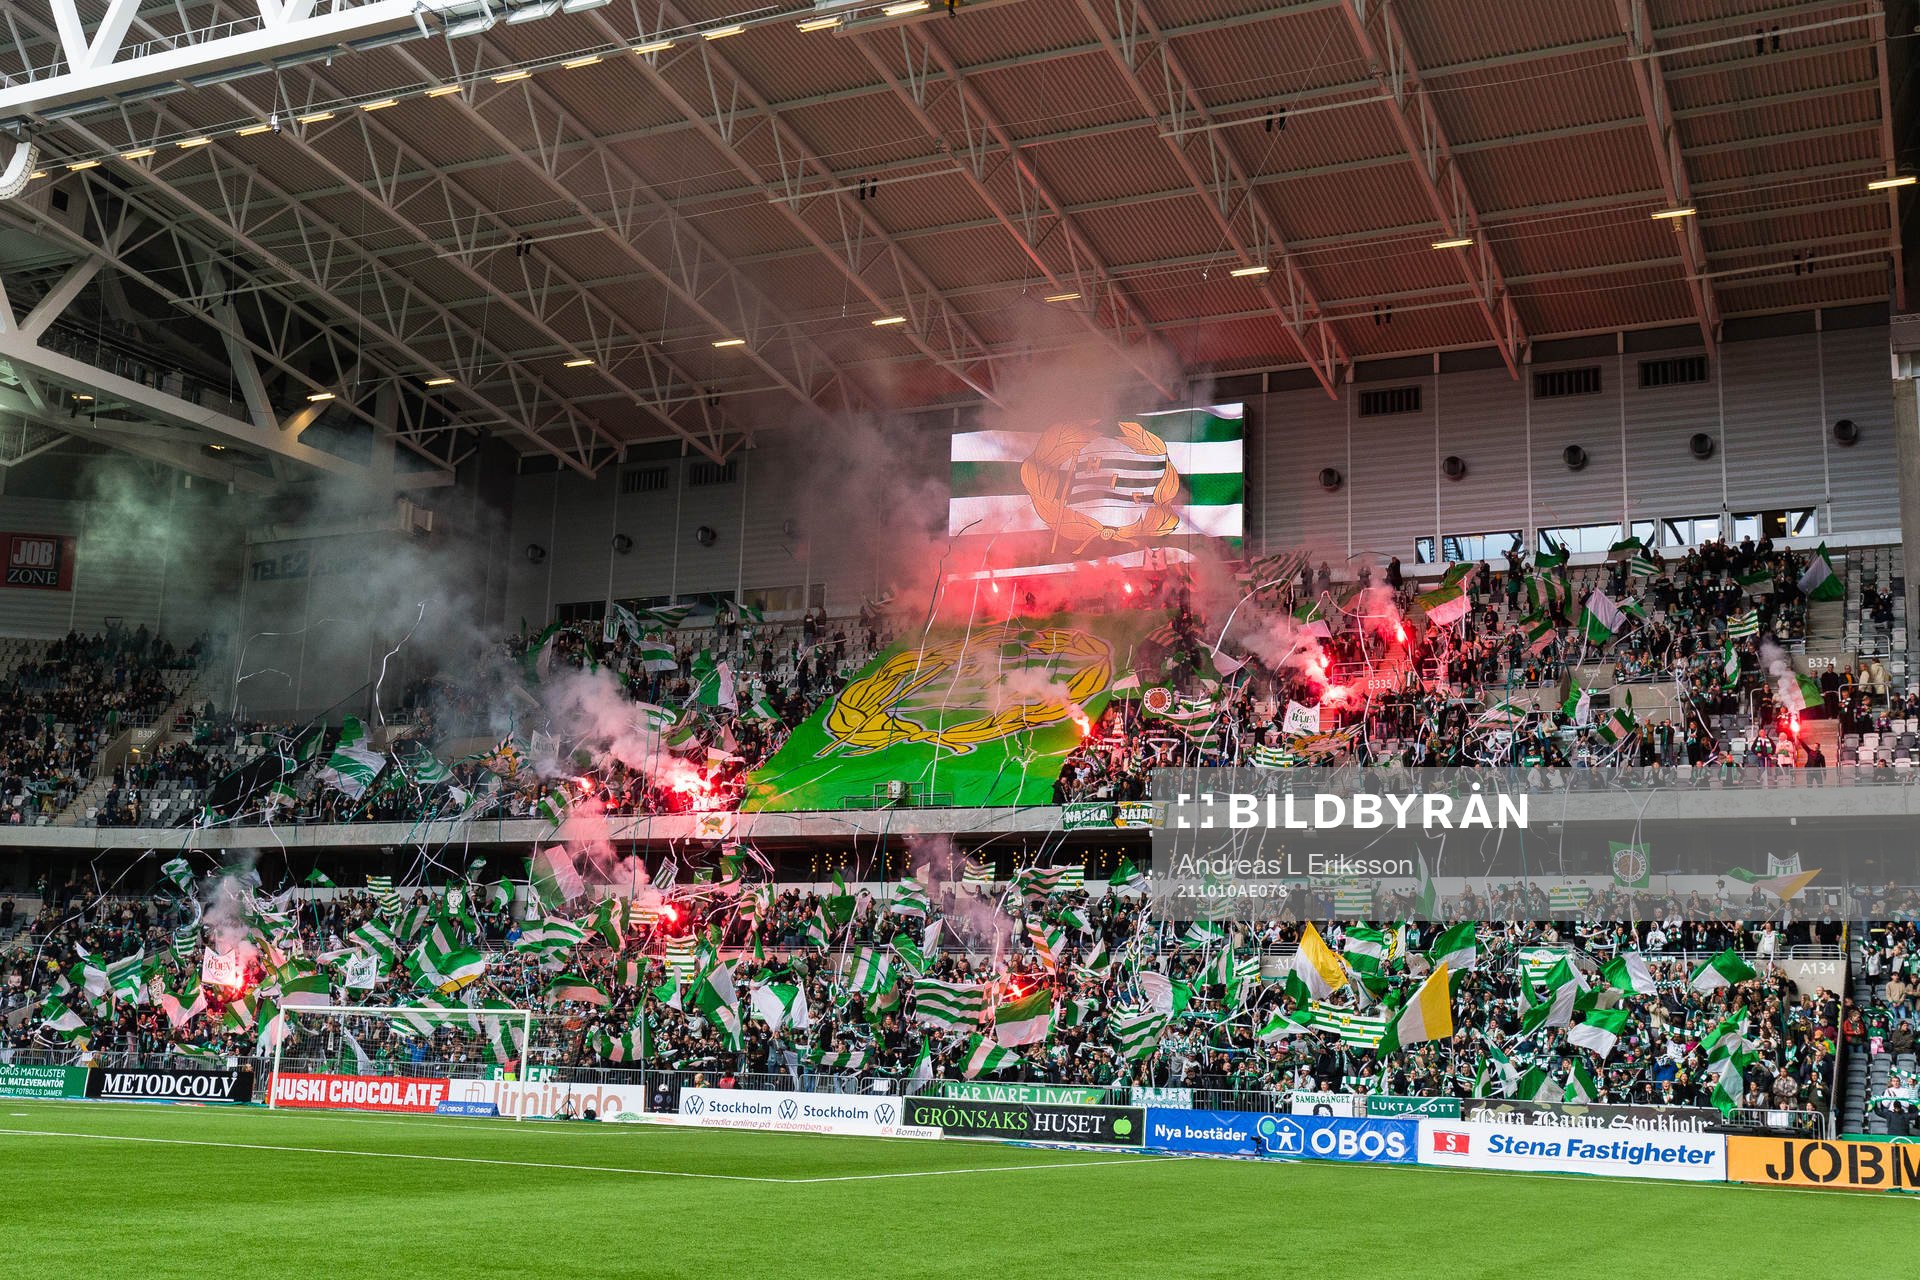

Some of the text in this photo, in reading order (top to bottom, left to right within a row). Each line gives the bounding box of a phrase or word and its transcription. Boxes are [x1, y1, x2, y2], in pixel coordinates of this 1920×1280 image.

[13, 541, 53, 565] JOB
[8, 569, 57, 584] ZONE
[1808, 657, 1837, 668] B334
[1368, 680, 1391, 689] B335
[1065, 810, 1108, 823] NACKA
[1800, 962, 1835, 974] A134
[20, 1067, 66, 1078] MATKLUSTER
[8, 1078, 65, 1088] MATLEVERANTÖR
[101, 1073, 235, 1097] METODGOLV
[15, 1087, 43, 1095] FOTBOLLS
[275, 1078, 444, 1107] HUSKI CHOCOLATE
[949, 1085, 981, 1101] HÄR
[1132, 1087, 1191, 1101] BAJEN
[493, 1082, 623, 1118] limitado
[1371, 1102, 1455, 1113] LUKTA GOTT
[709, 1101, 772, 1115] Stockholm
[804, 1105, 868, 1119] Stockholm
[701, 1118, 732, 1127] Handla
[732, 1121, 760, 1129] online
[773, 1121, 833, 1133] icabomben.se
[914, 1106, 1105, 1135] GRÖNSAKS HUSET
[895, 1128, 933, 1138] Bomben
[1155, 1124, 1248, 1143] Nya bostäder
[1311, 1127, 1406, 1159] OBOS
[1446, 1134, 1457, 1153] S
[1488, 1134, 1716, 1166] Stena Fastigheter
